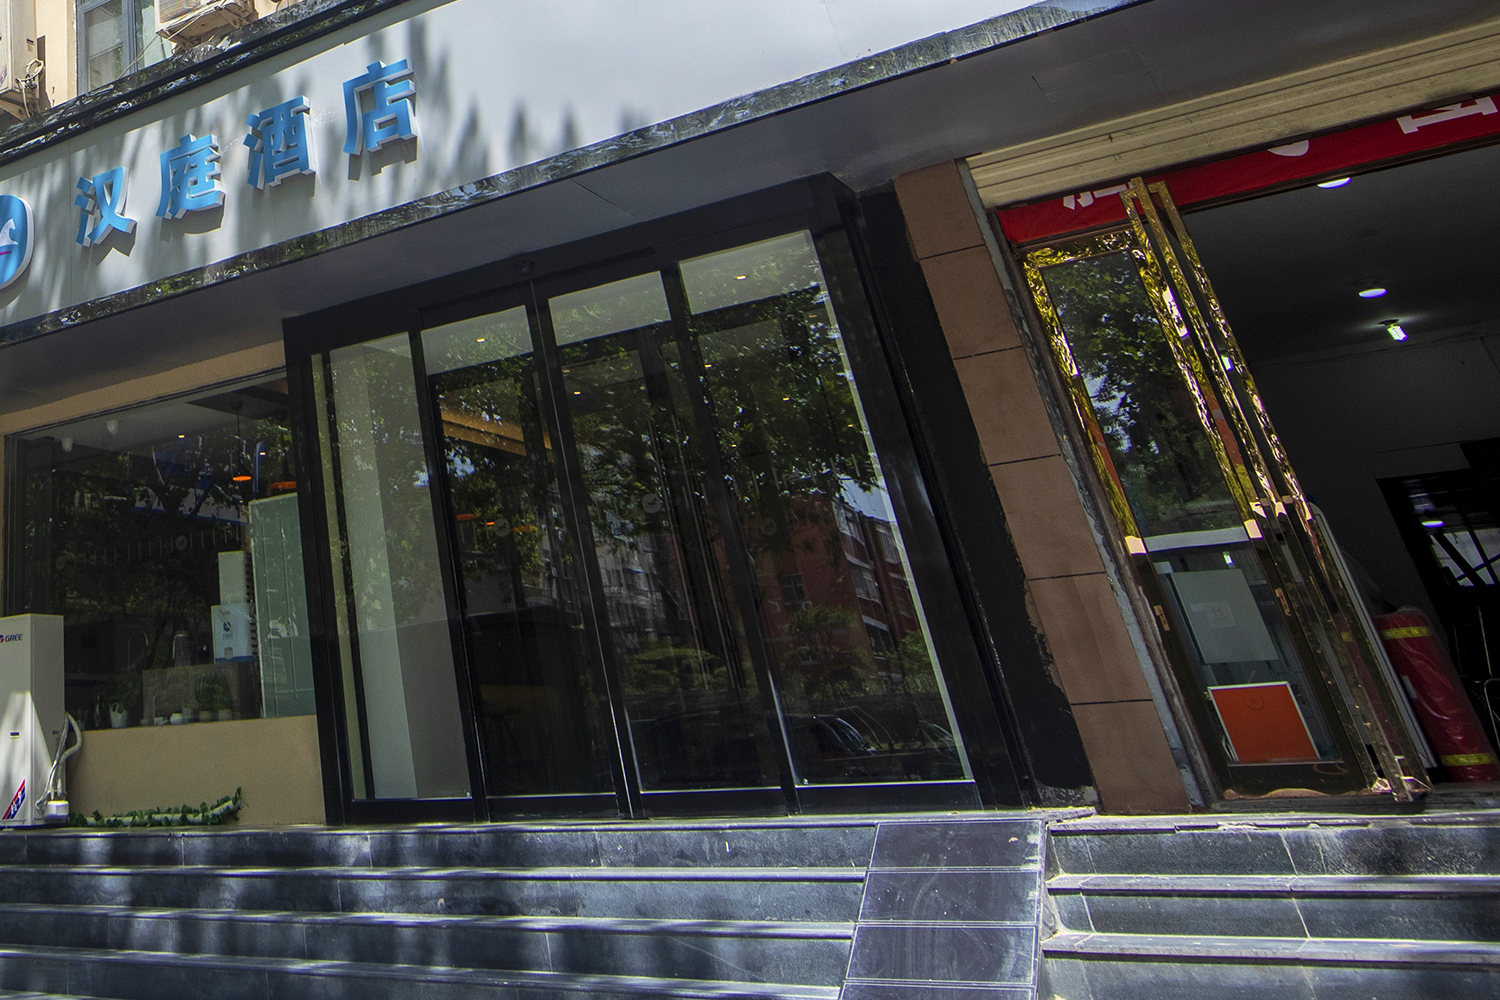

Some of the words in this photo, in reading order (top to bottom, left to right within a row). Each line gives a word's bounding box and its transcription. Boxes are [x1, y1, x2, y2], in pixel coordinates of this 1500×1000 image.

[74, 59, 417, 249] 汉庭酒店
[5, 633, 23, 643] GREE
